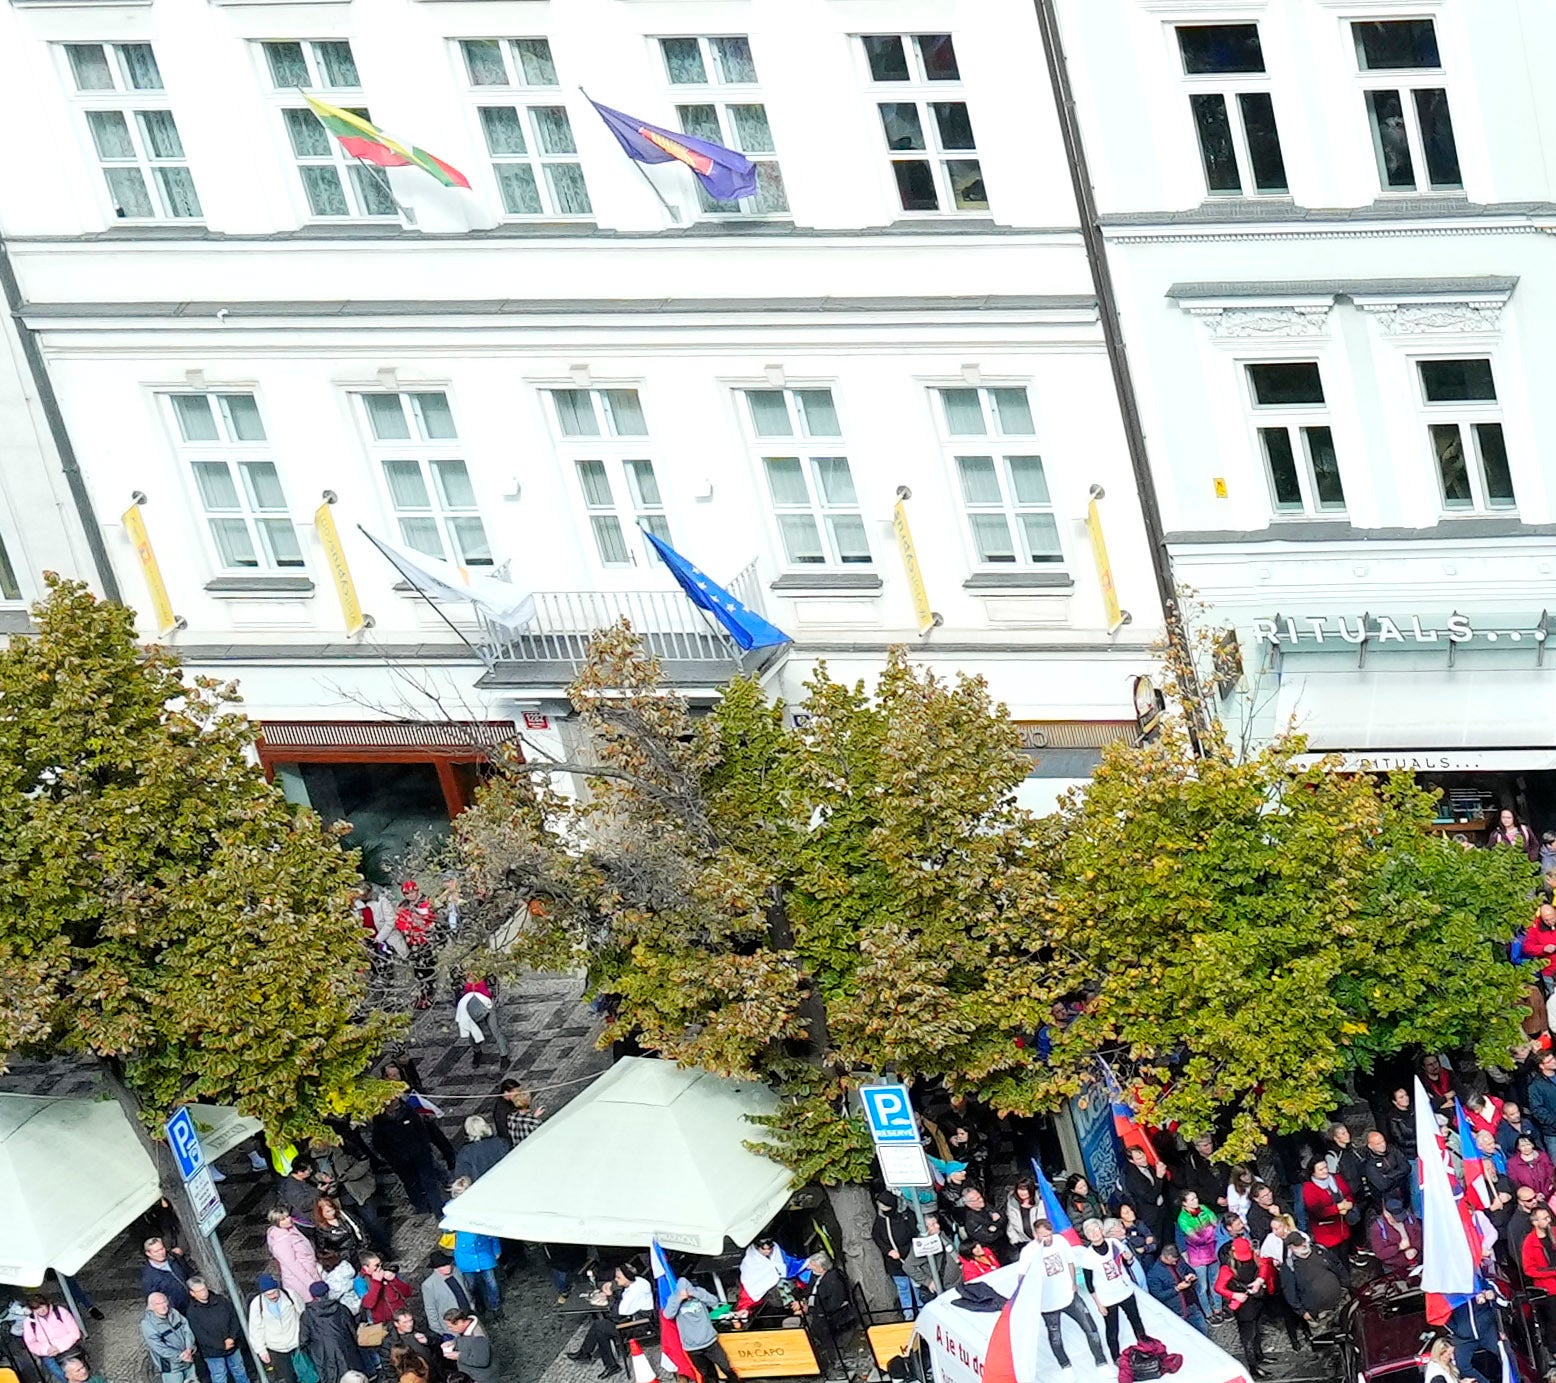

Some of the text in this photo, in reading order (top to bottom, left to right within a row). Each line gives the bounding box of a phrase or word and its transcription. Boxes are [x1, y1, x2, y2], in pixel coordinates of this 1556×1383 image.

[1254, 615, 1547, 645] RITUALS...
[873, 1093, 903, 1127] P
[174, 1119, 190, 1160] P
[755, 1346, 785, 1358] CAPO
[935, 1324, 944, 1343] A
[944, 1333, 956, 1356] je
[959, 1345, 970, 1368] tu
